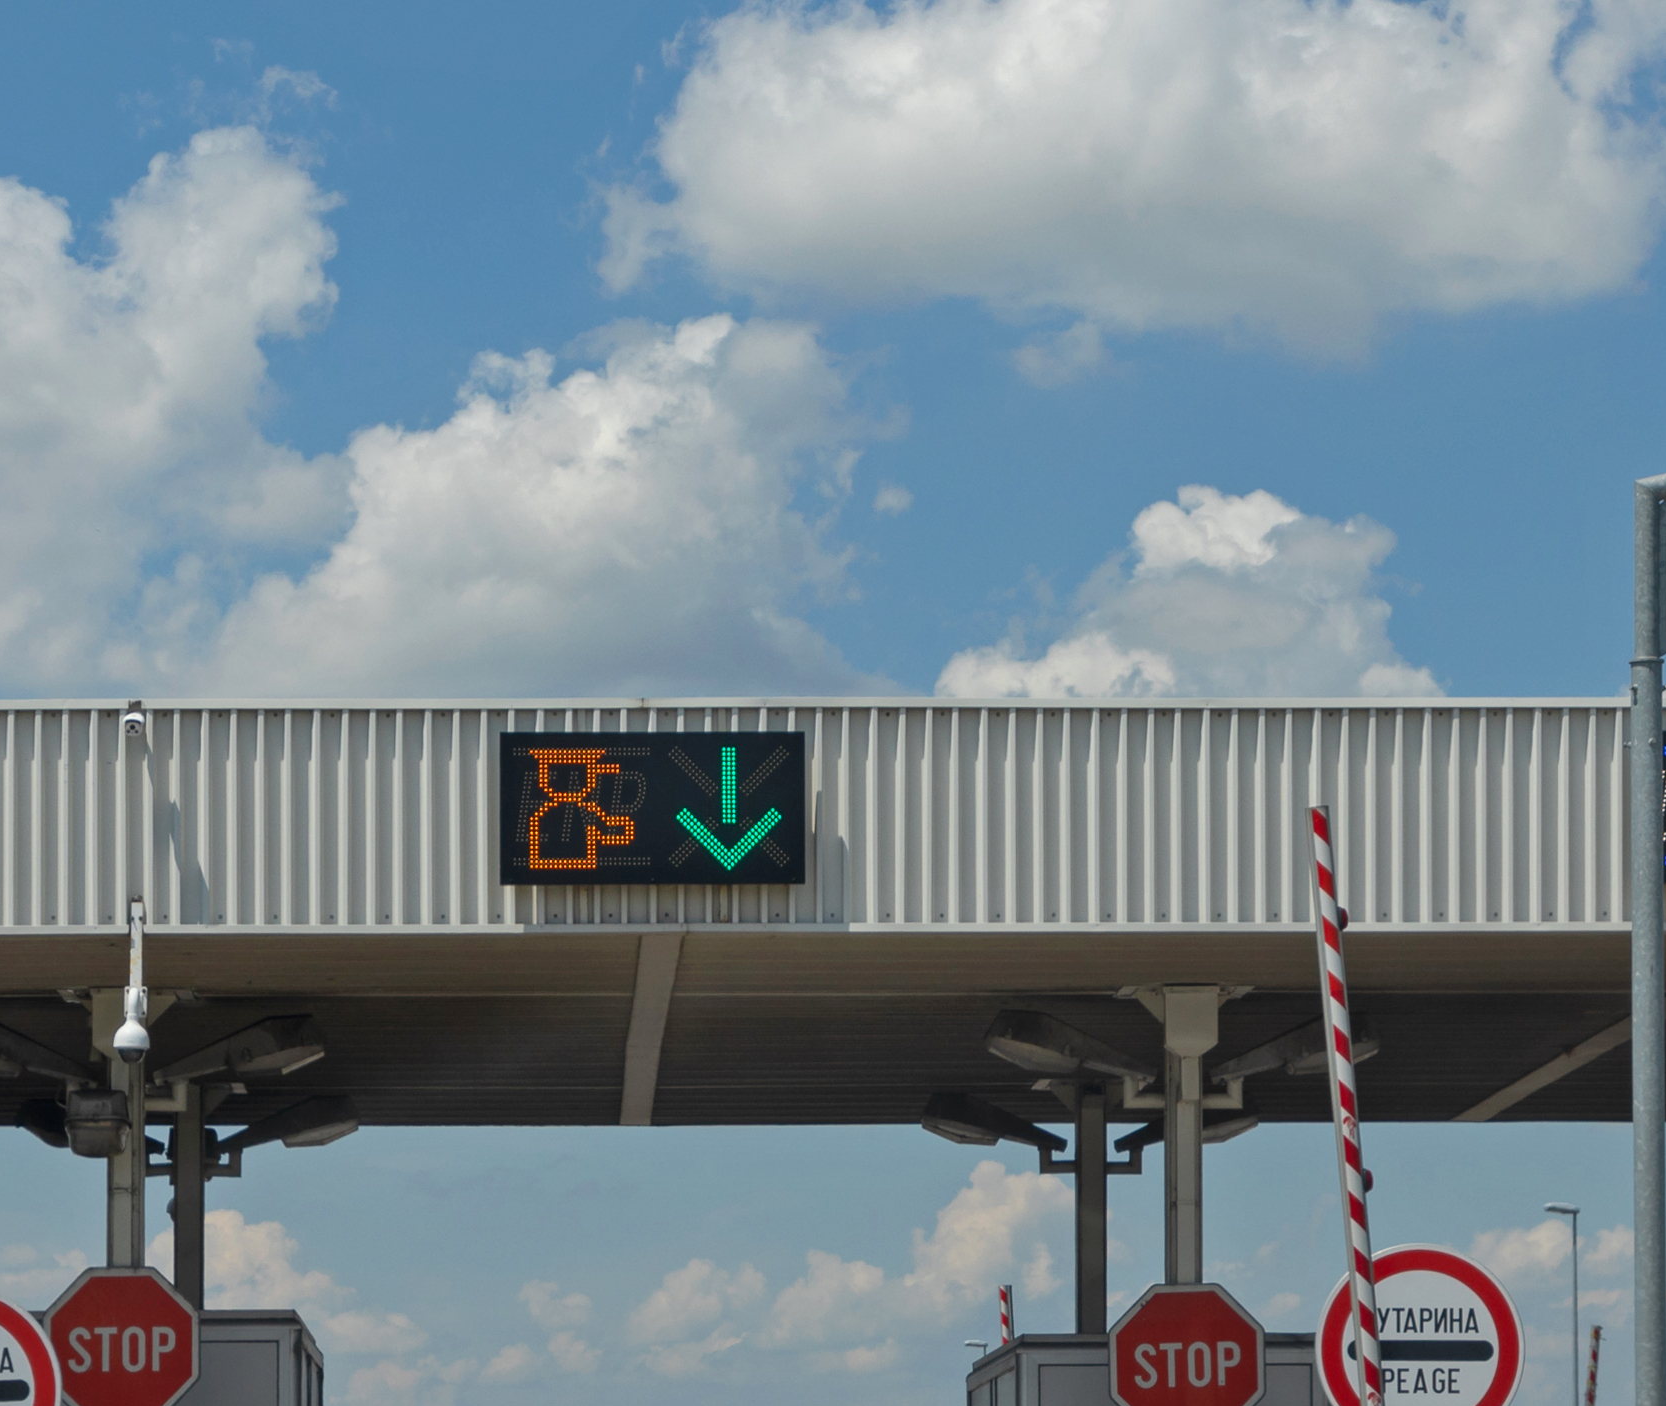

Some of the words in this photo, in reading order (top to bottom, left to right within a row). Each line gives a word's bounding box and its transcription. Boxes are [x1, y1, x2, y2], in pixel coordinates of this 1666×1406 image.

[1377, 1307, 1480, 1334] УТАРИНА
[67, 1326, 176, 1374] STOP
[1134, 1341, 1241, 1389] STOP
[1383, 1367, 1461, 1394] PEAGE
